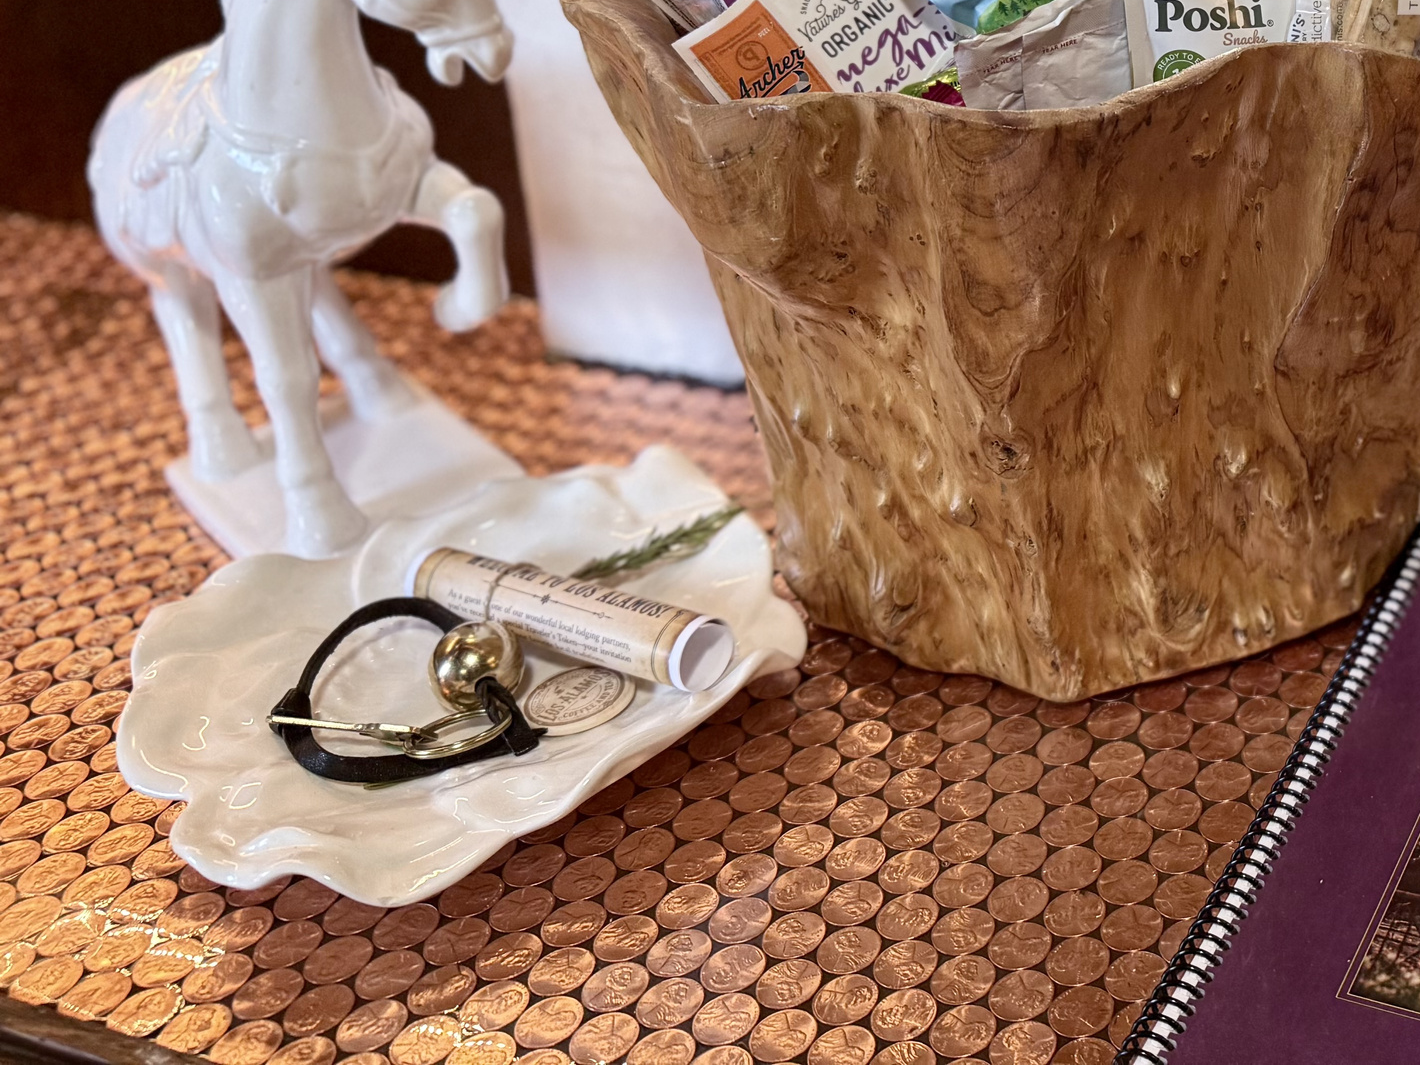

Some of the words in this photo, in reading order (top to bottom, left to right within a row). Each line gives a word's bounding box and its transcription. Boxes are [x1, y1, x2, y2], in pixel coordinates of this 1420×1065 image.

[798, 3, 846, 42] Nature's
[1222, 29, 1268, 46] Snacks
[905, 24, 957, 70] Mi
[1000, 56, 1019, 66] HERE
[1060, 39, 1079, 49] HERE
[1157, 52, 1180, 71] READY
[1182, 52, 1194, 61] TO
[738, 46, 806, 100] Archer
[563, 582, 602, 598] LOS
[595, 590, 674, 619] ALAMOS!
[526, 613, 558, 629] wonderful
[558, 621, 575, 633] local
[575, 625, 601, 644] lodging
[602, 636, 632, 652] partners,
